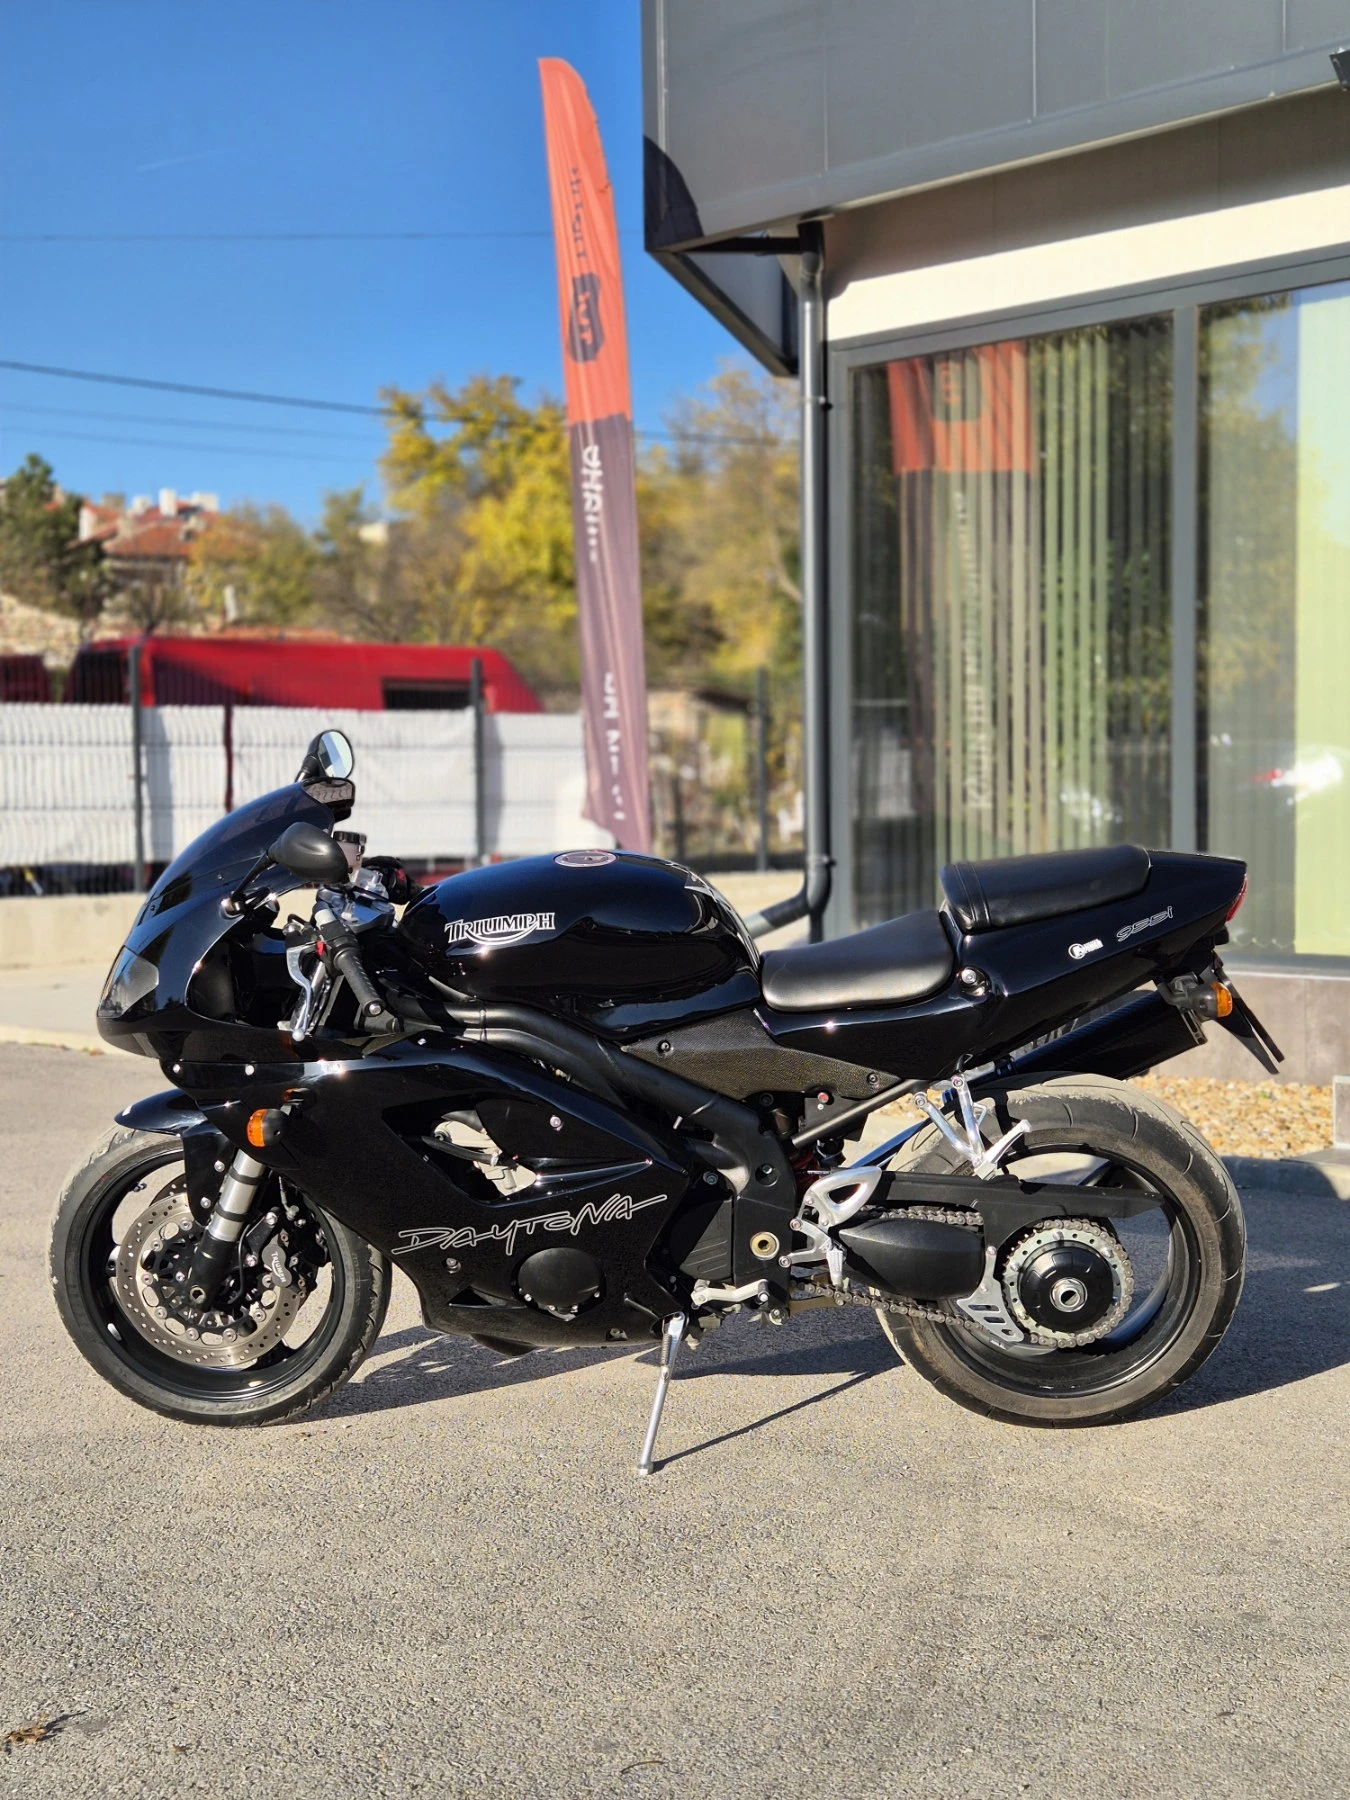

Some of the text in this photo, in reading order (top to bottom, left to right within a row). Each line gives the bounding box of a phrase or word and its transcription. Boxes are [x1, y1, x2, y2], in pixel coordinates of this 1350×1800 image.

[444, 912, 556, 945] TRIUMPH
[1117, 905, 1174, 942] 955i
[391, 1193, 667, 1256] DAYTONA
